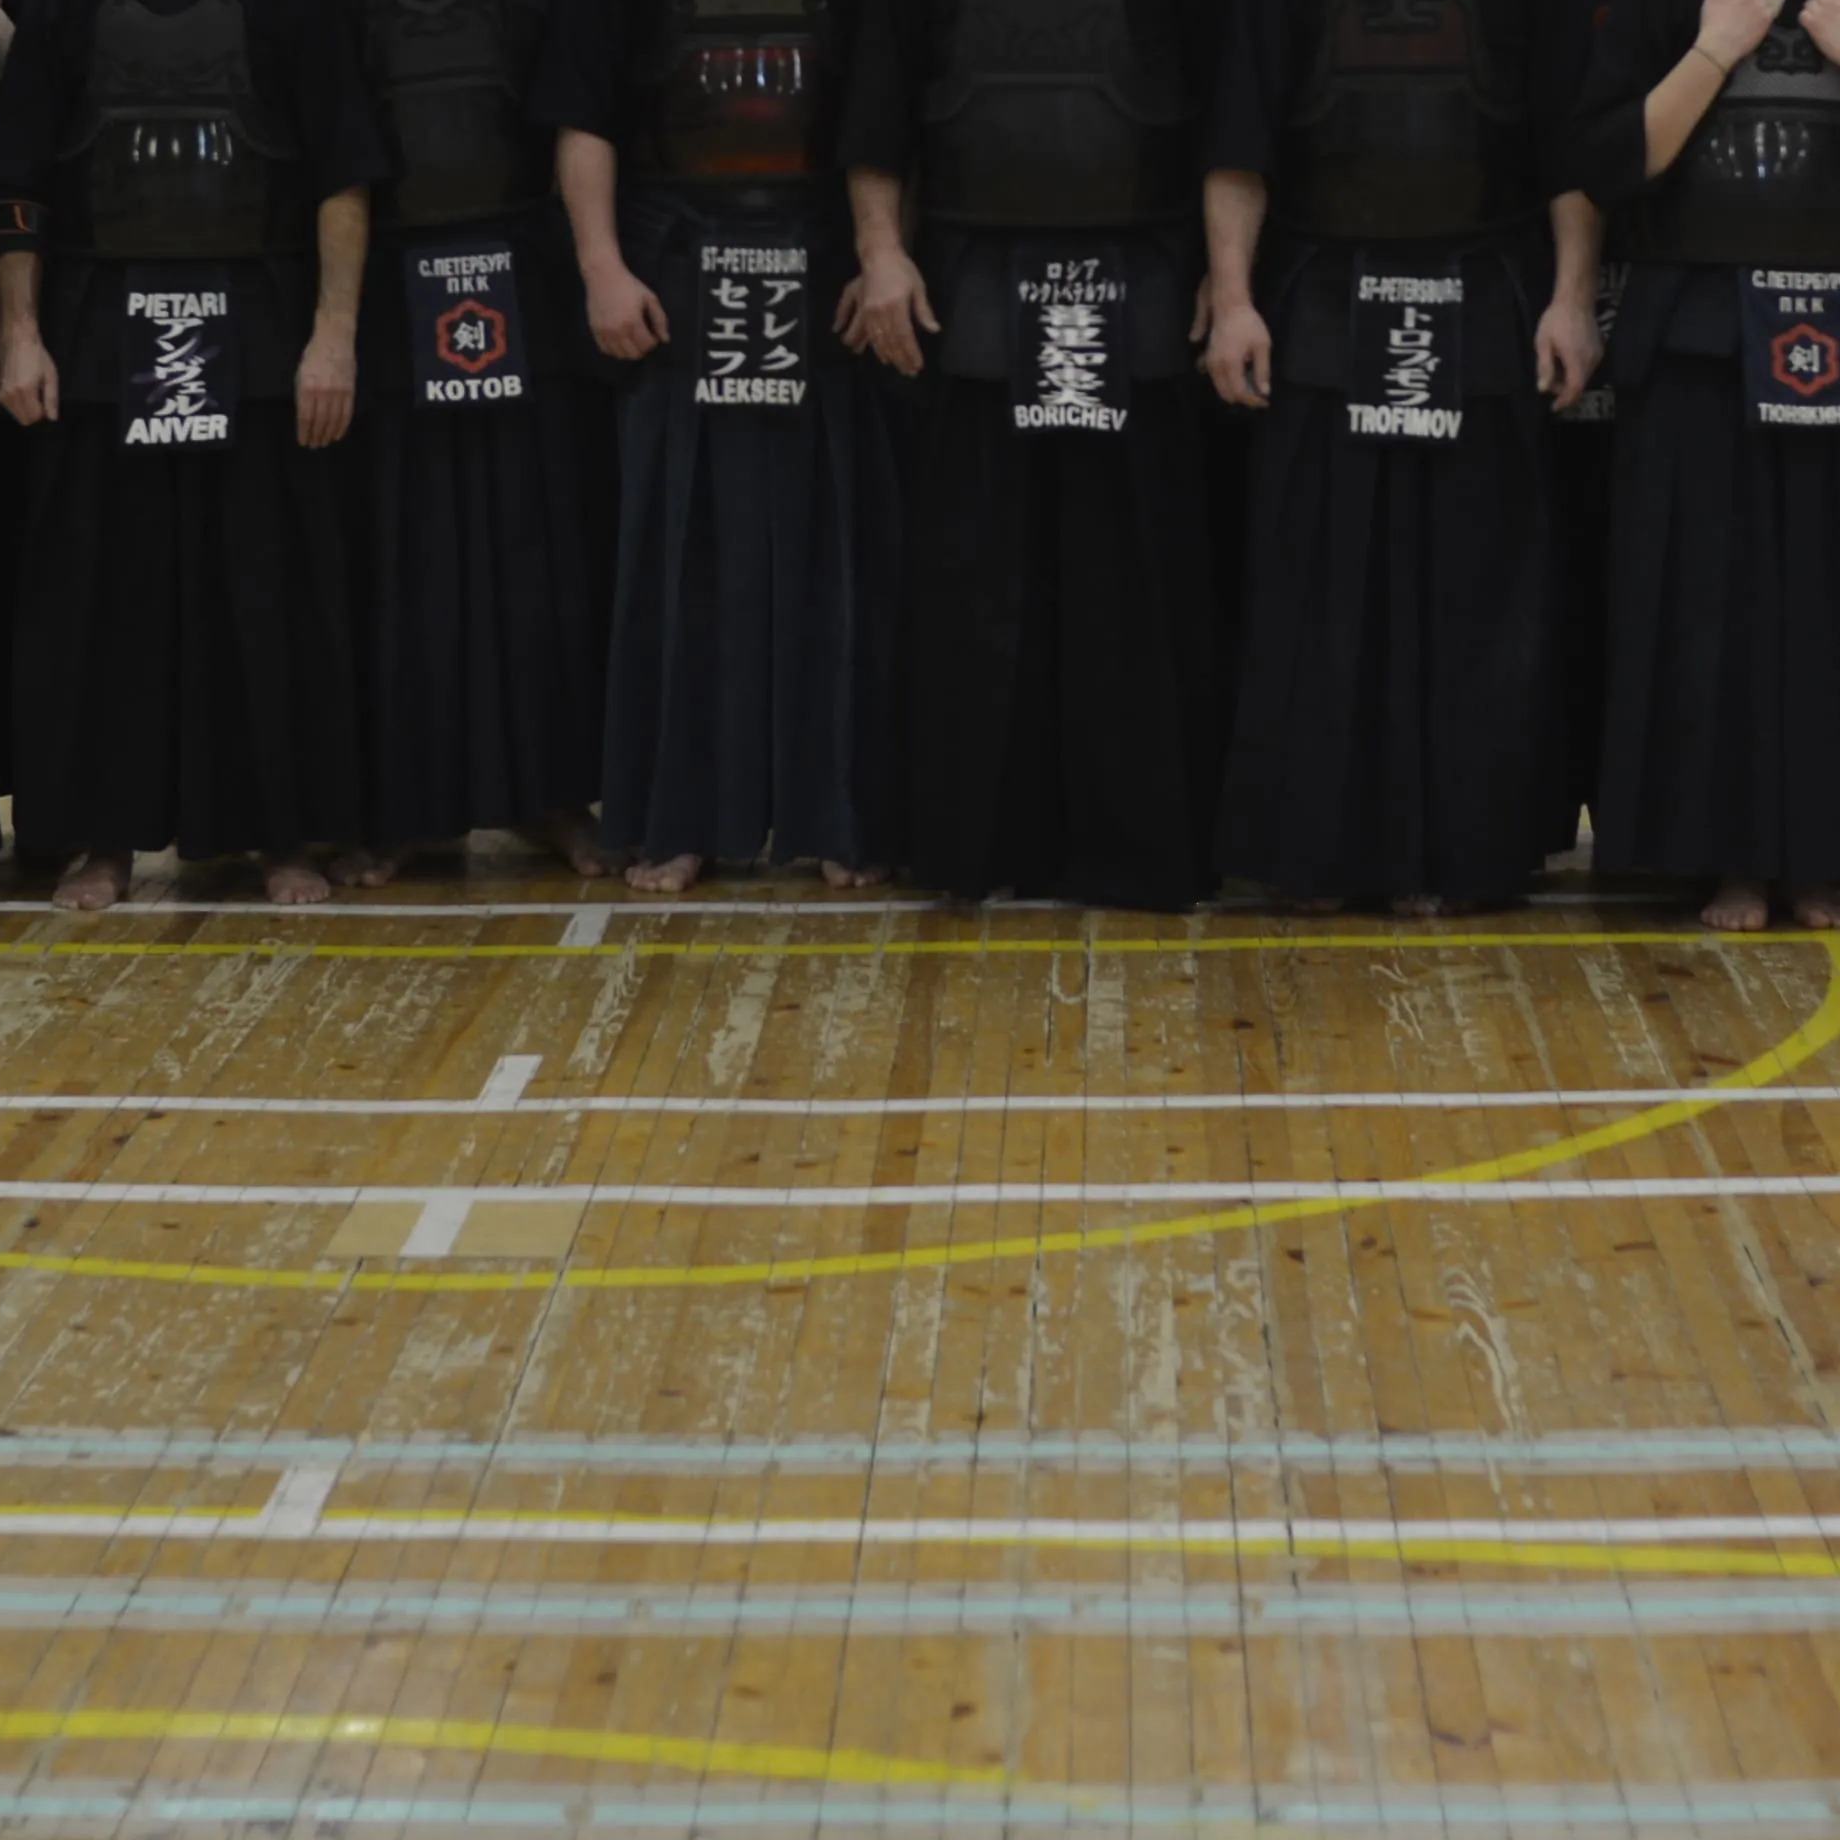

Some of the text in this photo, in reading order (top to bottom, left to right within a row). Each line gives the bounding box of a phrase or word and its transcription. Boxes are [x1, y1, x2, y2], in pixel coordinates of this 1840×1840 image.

[417, 251, 513, 278] С.ПЕТЕРБУРГ
[126, 292, 228, 319] PIETARI
[425, 374, 524, 402] КОТОВ
[694, 377, 808, 407] ALEKSEEV
[124, 413, 229, 445] ANVER
[1012, 404, 1128, 433] BORICHEV
[1346, 403, 1464, 440] TROFIMOV
